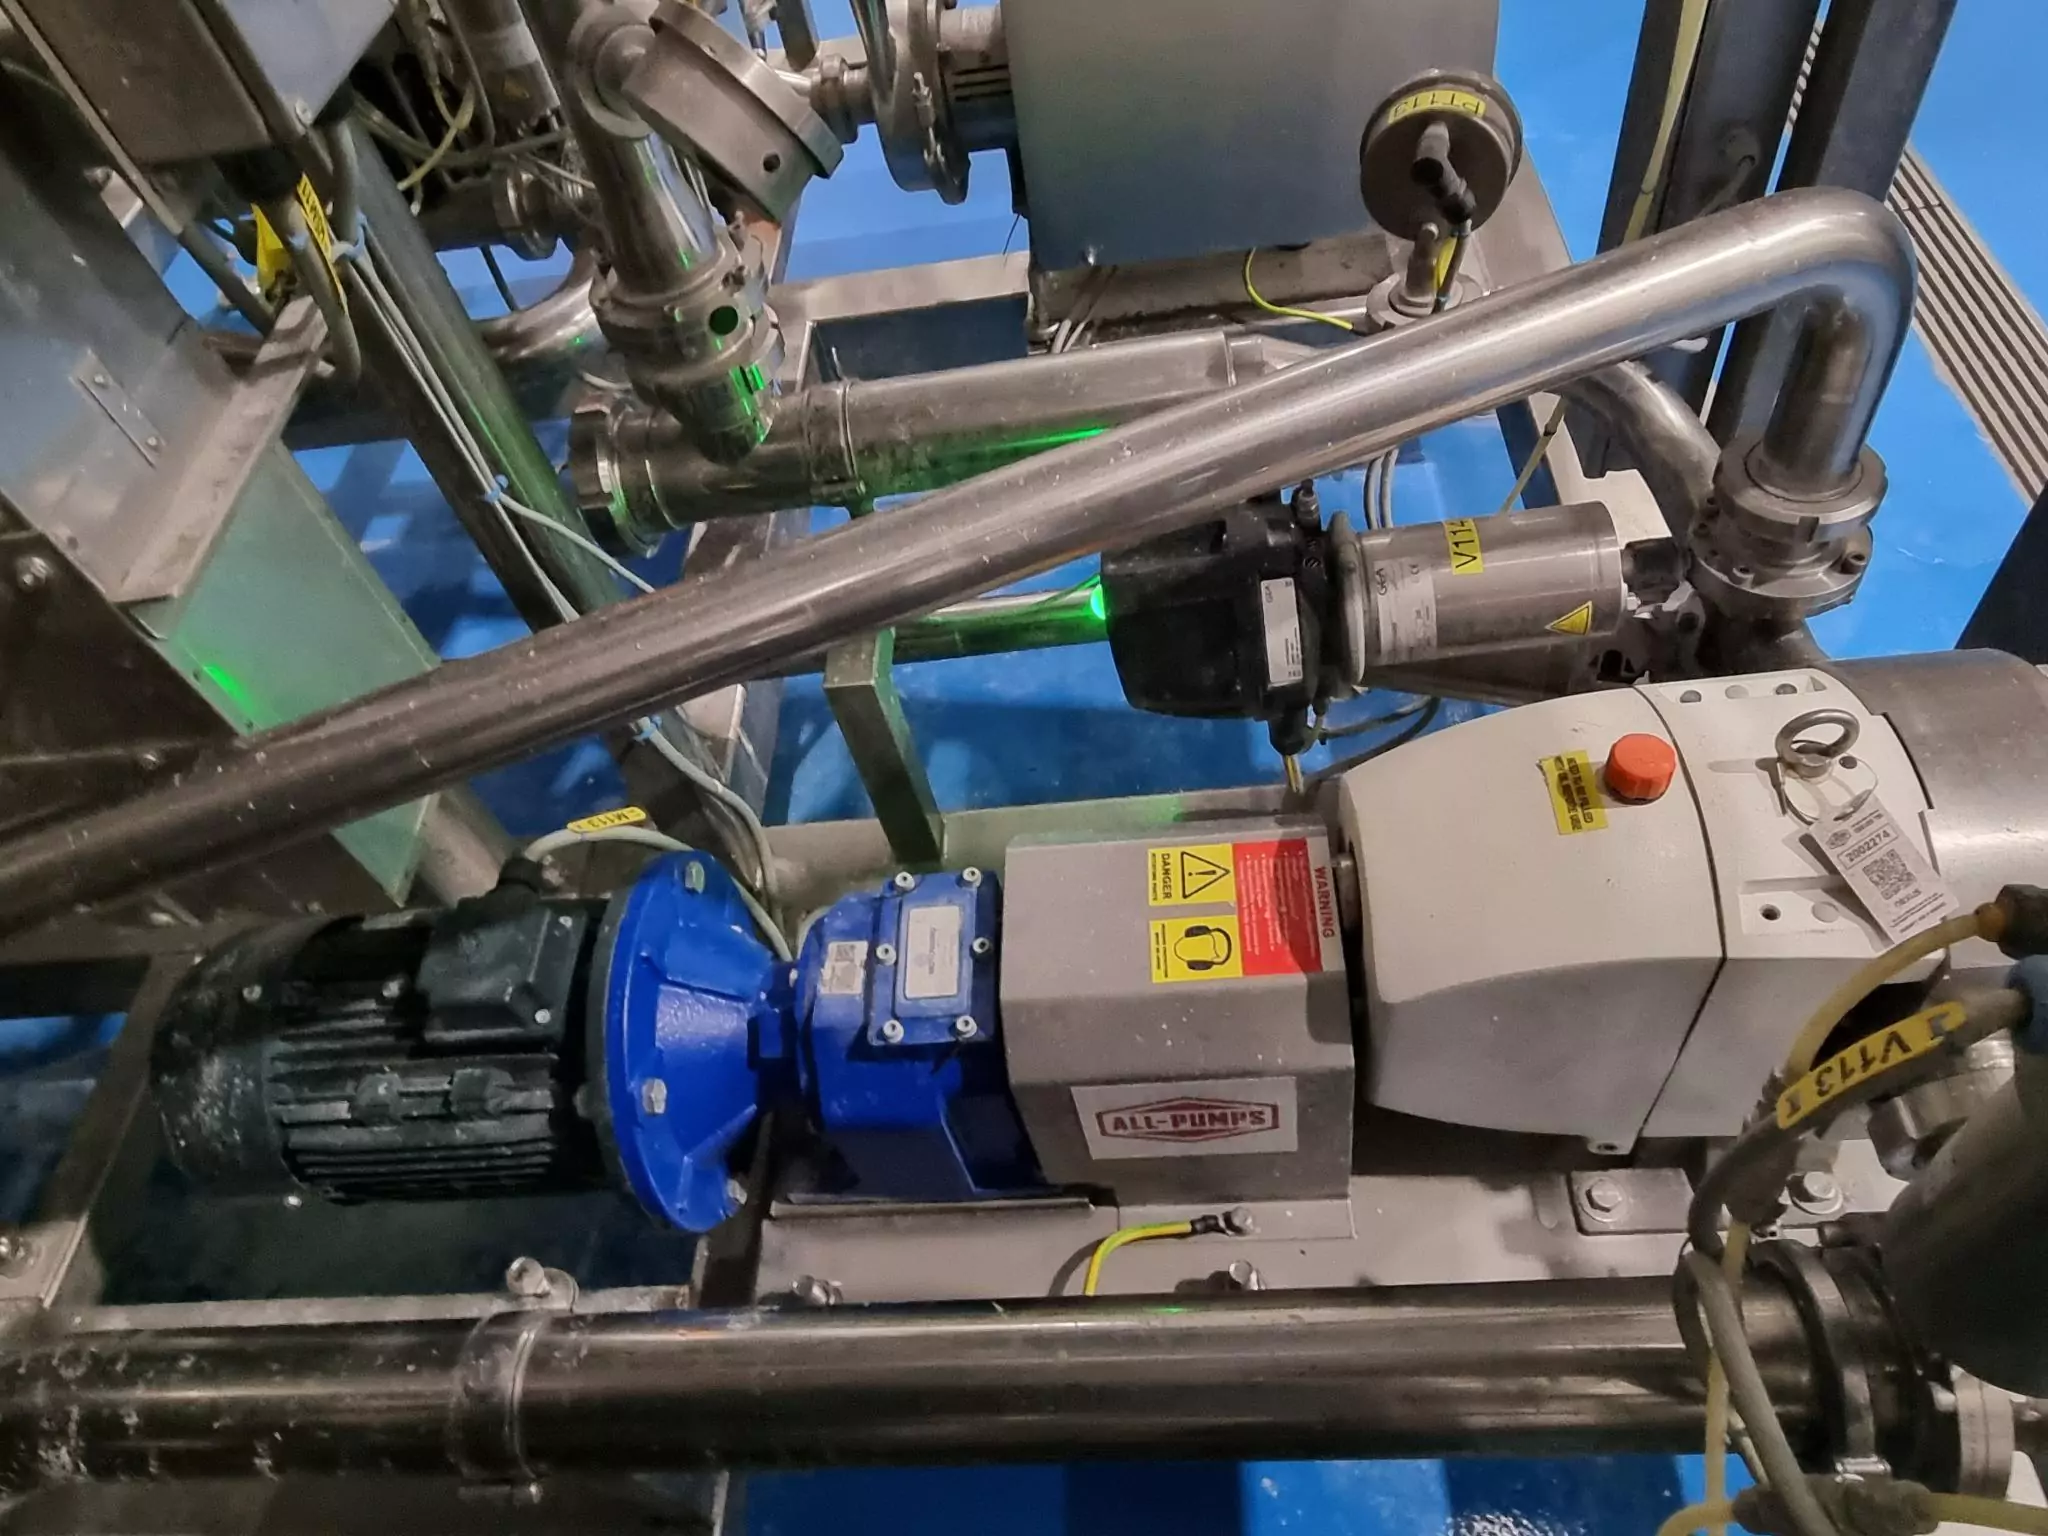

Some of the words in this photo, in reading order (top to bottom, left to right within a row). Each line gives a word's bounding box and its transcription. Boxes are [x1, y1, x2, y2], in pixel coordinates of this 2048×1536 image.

[1161, 853, 1173, 900] DANGER
[1314, 865, 1335, 938] WARNING
[1814, 1030, 1912, 1096] V113
[1112, 1110, 1267, 1131] ALL-PUMPS
